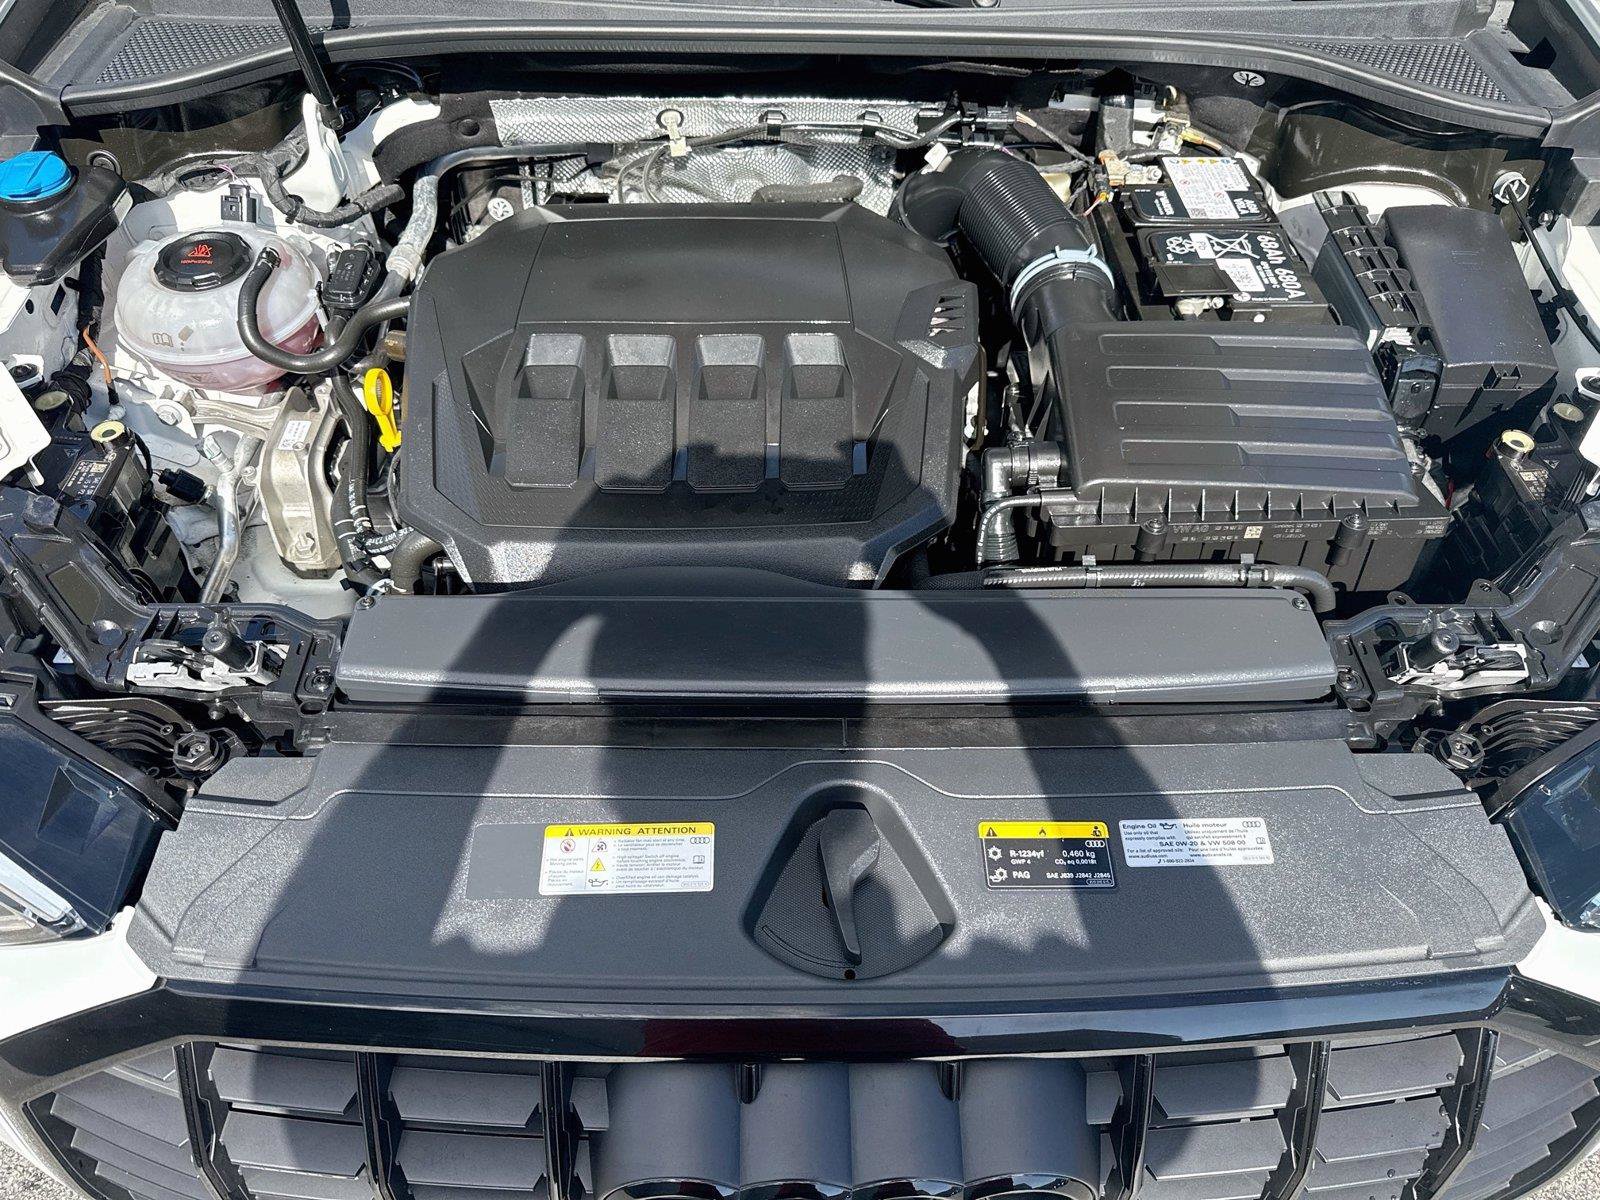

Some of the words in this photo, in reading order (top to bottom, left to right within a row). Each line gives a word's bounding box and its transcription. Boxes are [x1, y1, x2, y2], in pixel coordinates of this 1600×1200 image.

[1257, 234, 1287, 264] 68Ah
[1275, 268, 1306, 298] 680A
[579, 828, 631, 836] WARNING
[638, 827, 696, 835] ATTENTION
[1010, 850, 1044, 858] R-1234yf
[1086, 850, 1096, 858] kg
